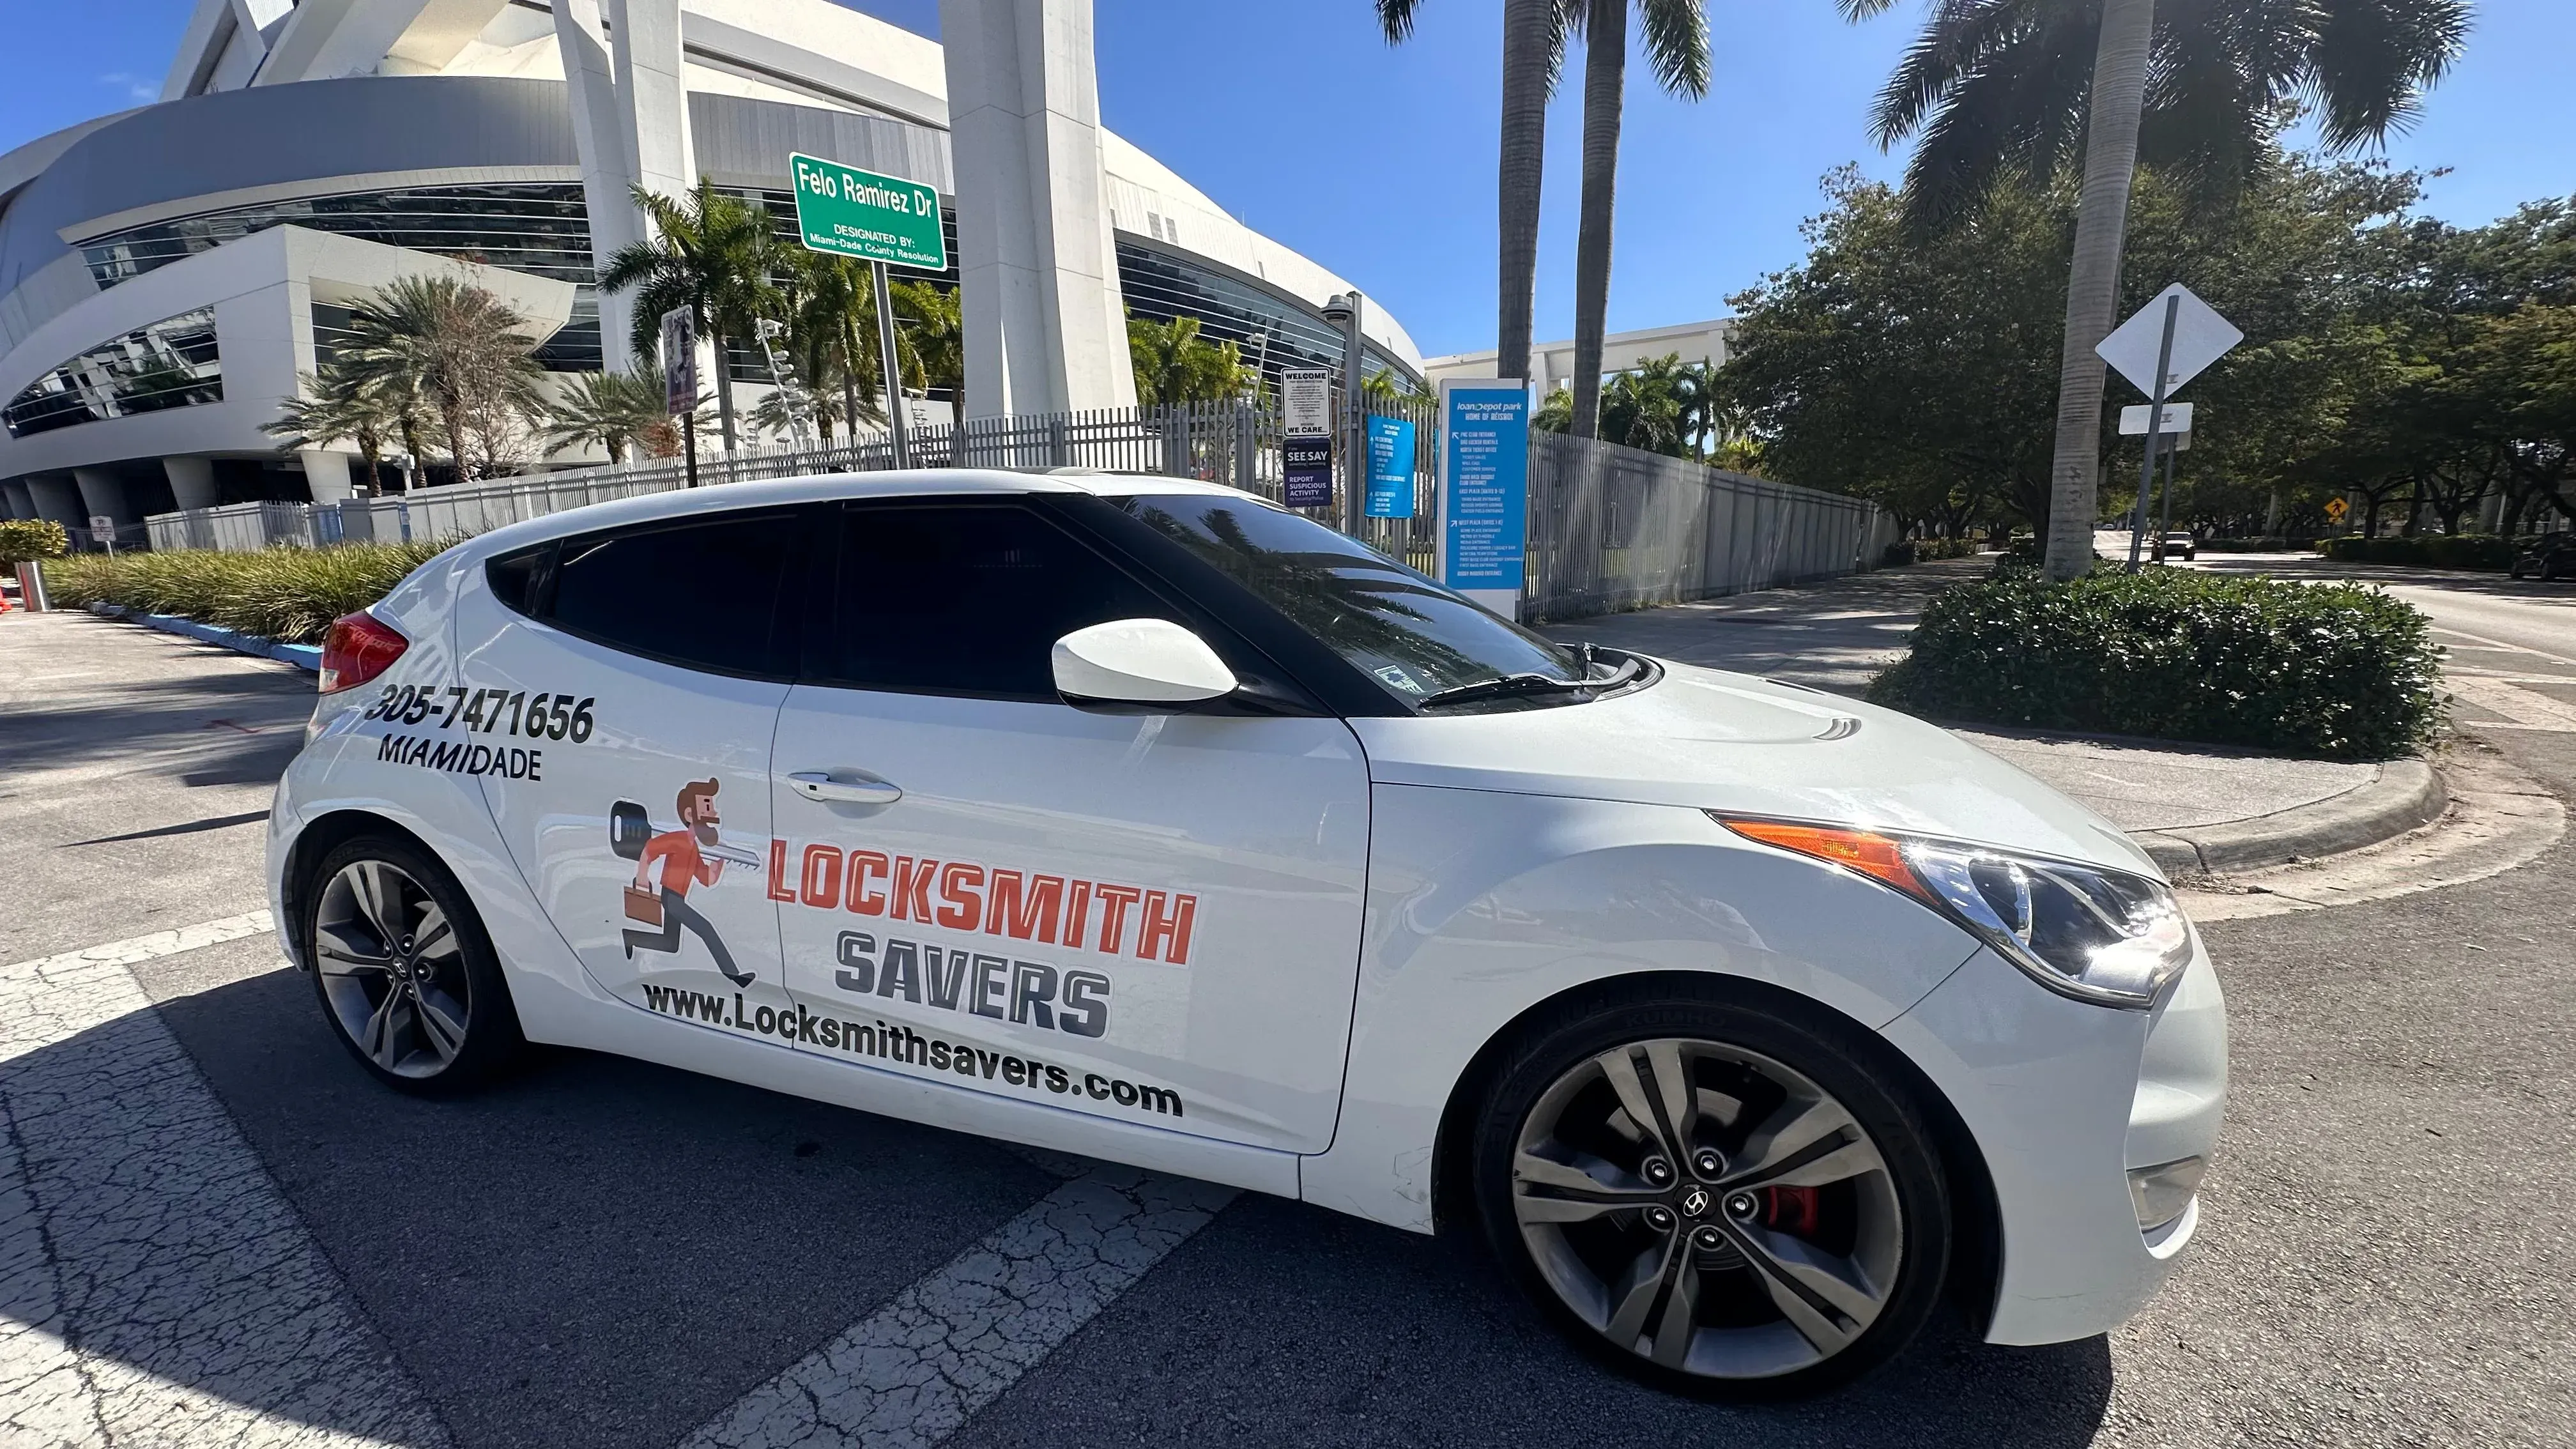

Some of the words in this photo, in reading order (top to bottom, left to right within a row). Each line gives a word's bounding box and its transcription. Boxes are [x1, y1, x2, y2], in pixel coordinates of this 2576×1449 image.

[797, 162, 837, 198] Felo
[842, 173, 909, 214] Ramirez
[914, 190, 931, 218] Dr
[809, 233, 862, 251] Miami-Dade
[864, 243, 894, 257] County
[897, 249, 939, 263] Resolution
[833, 223, 896, 245] DESIGNATED
[900, 238, 916, 248] BY:
[1502, 402, 1522, 411] park
[1287, 452, 1306, 461] SEE
[1308, 451, 1328, 461] SAY
[364, 684, 595, 744] 305-7471656
[377, 733, 542, 781] MIAMIDADE
[767, 837, 1199, 965] LOCKSMITH
[834, 929, 1112, 1039] SAVERS
[1625, 1009, 1726, 1027] KUMHO
[641, 984, 1183, 1118] www.Locksmithsavers.com
